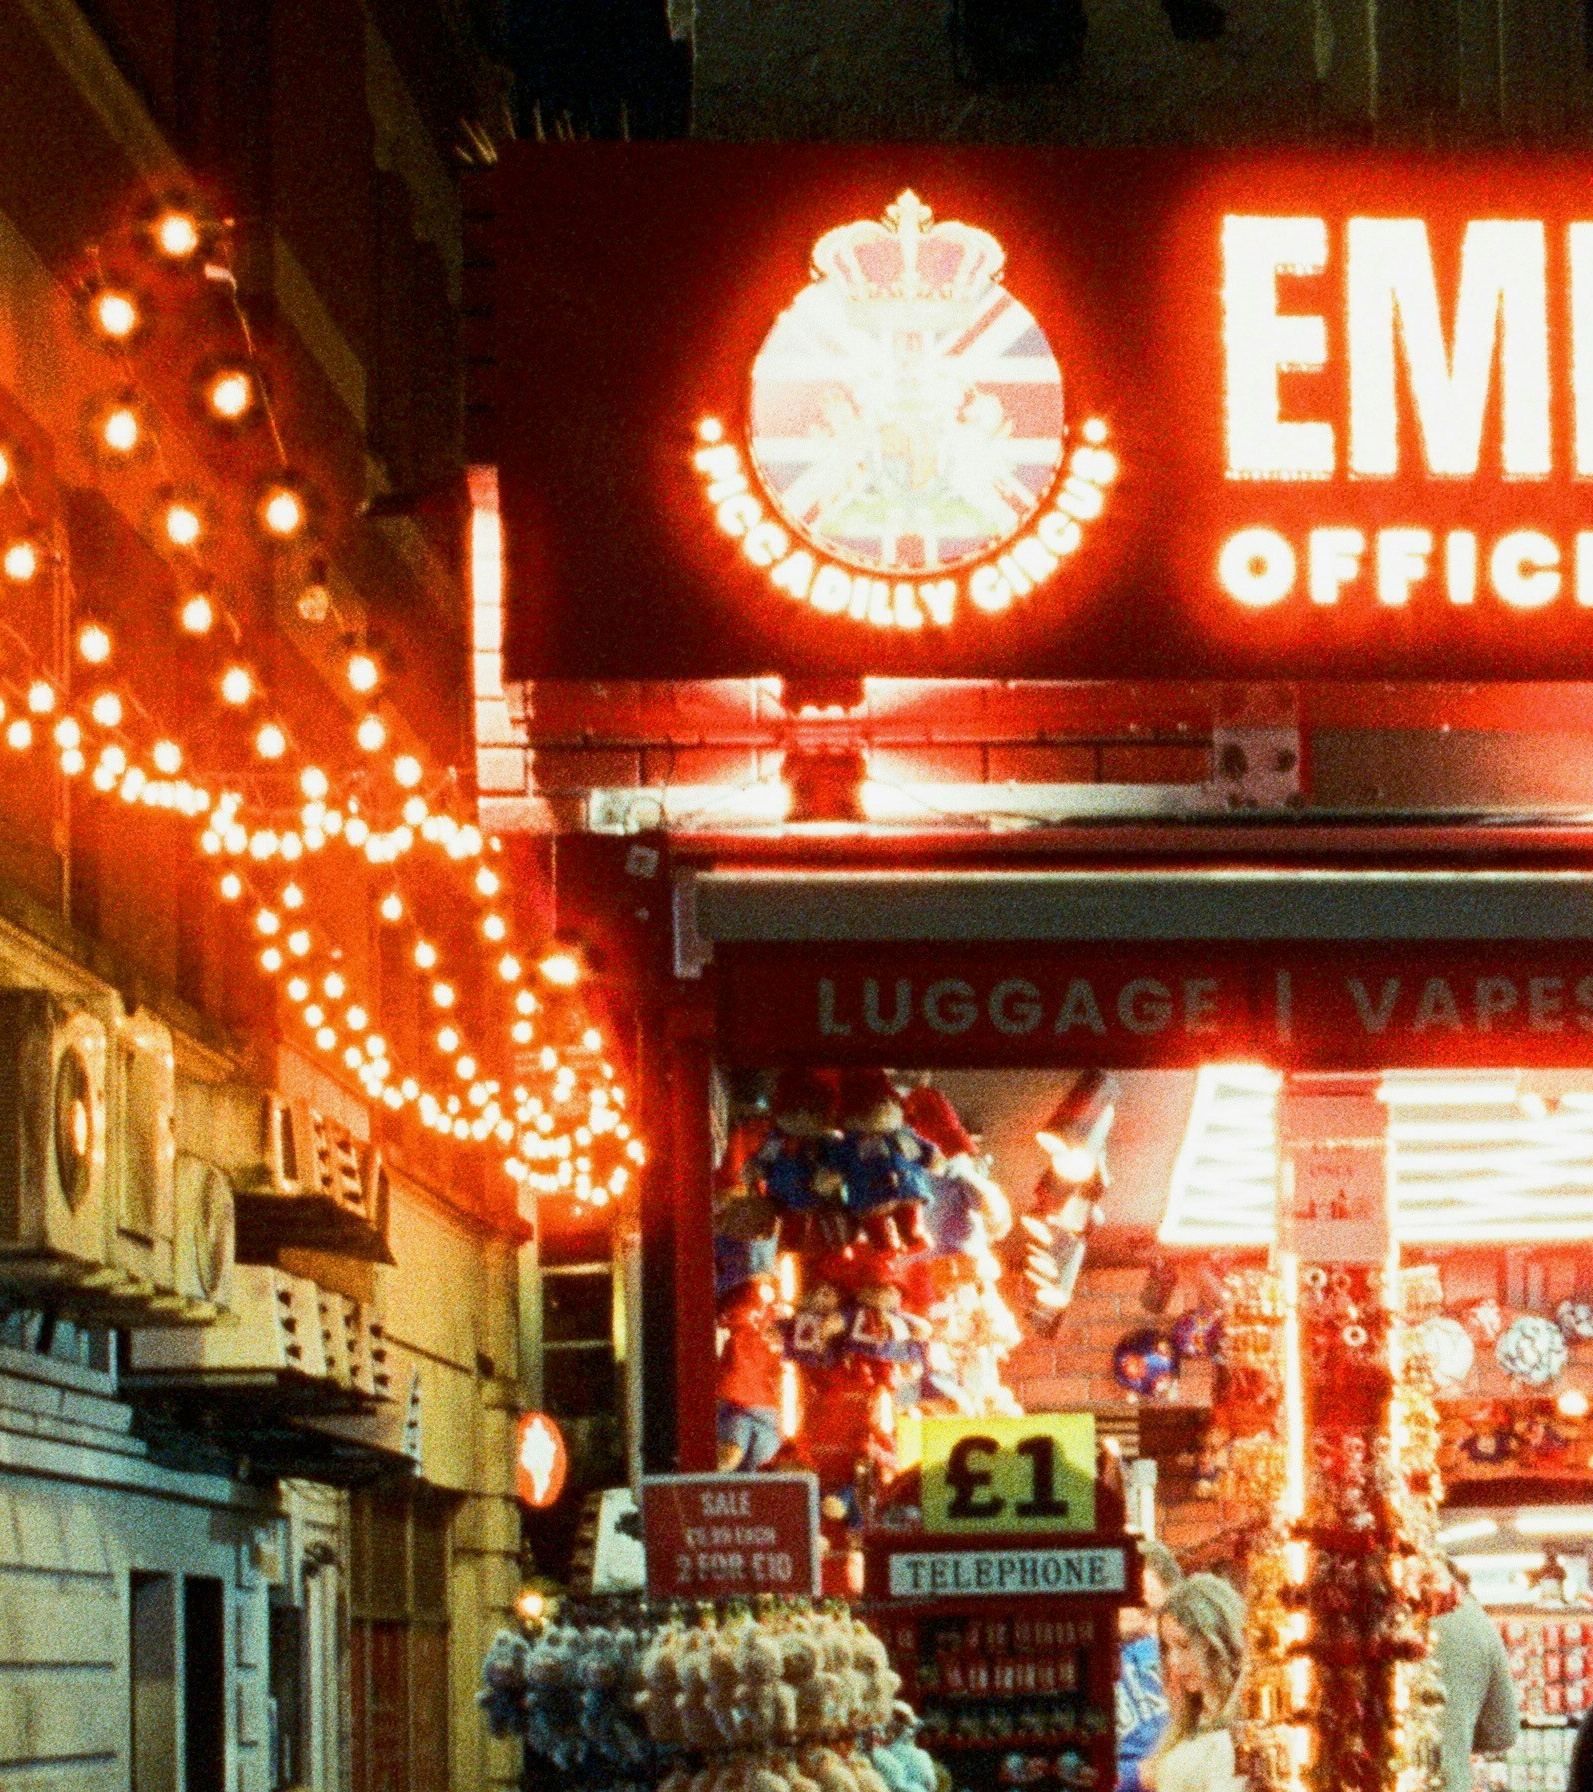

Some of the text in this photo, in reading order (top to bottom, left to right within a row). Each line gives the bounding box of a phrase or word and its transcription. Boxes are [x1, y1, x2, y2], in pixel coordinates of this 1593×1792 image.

[695, 444, 1119, 630] PICCADILLY CIRCUS
[816, 976, 1223, 1037] LUGGAGE
[945, 1434, 1070, 1519] £1
[700, 1490, 752, 1517] SALE
[698, 1551, 745, 1582] FOR
[907, 1556, 1109, 1592] TELEPHONE
